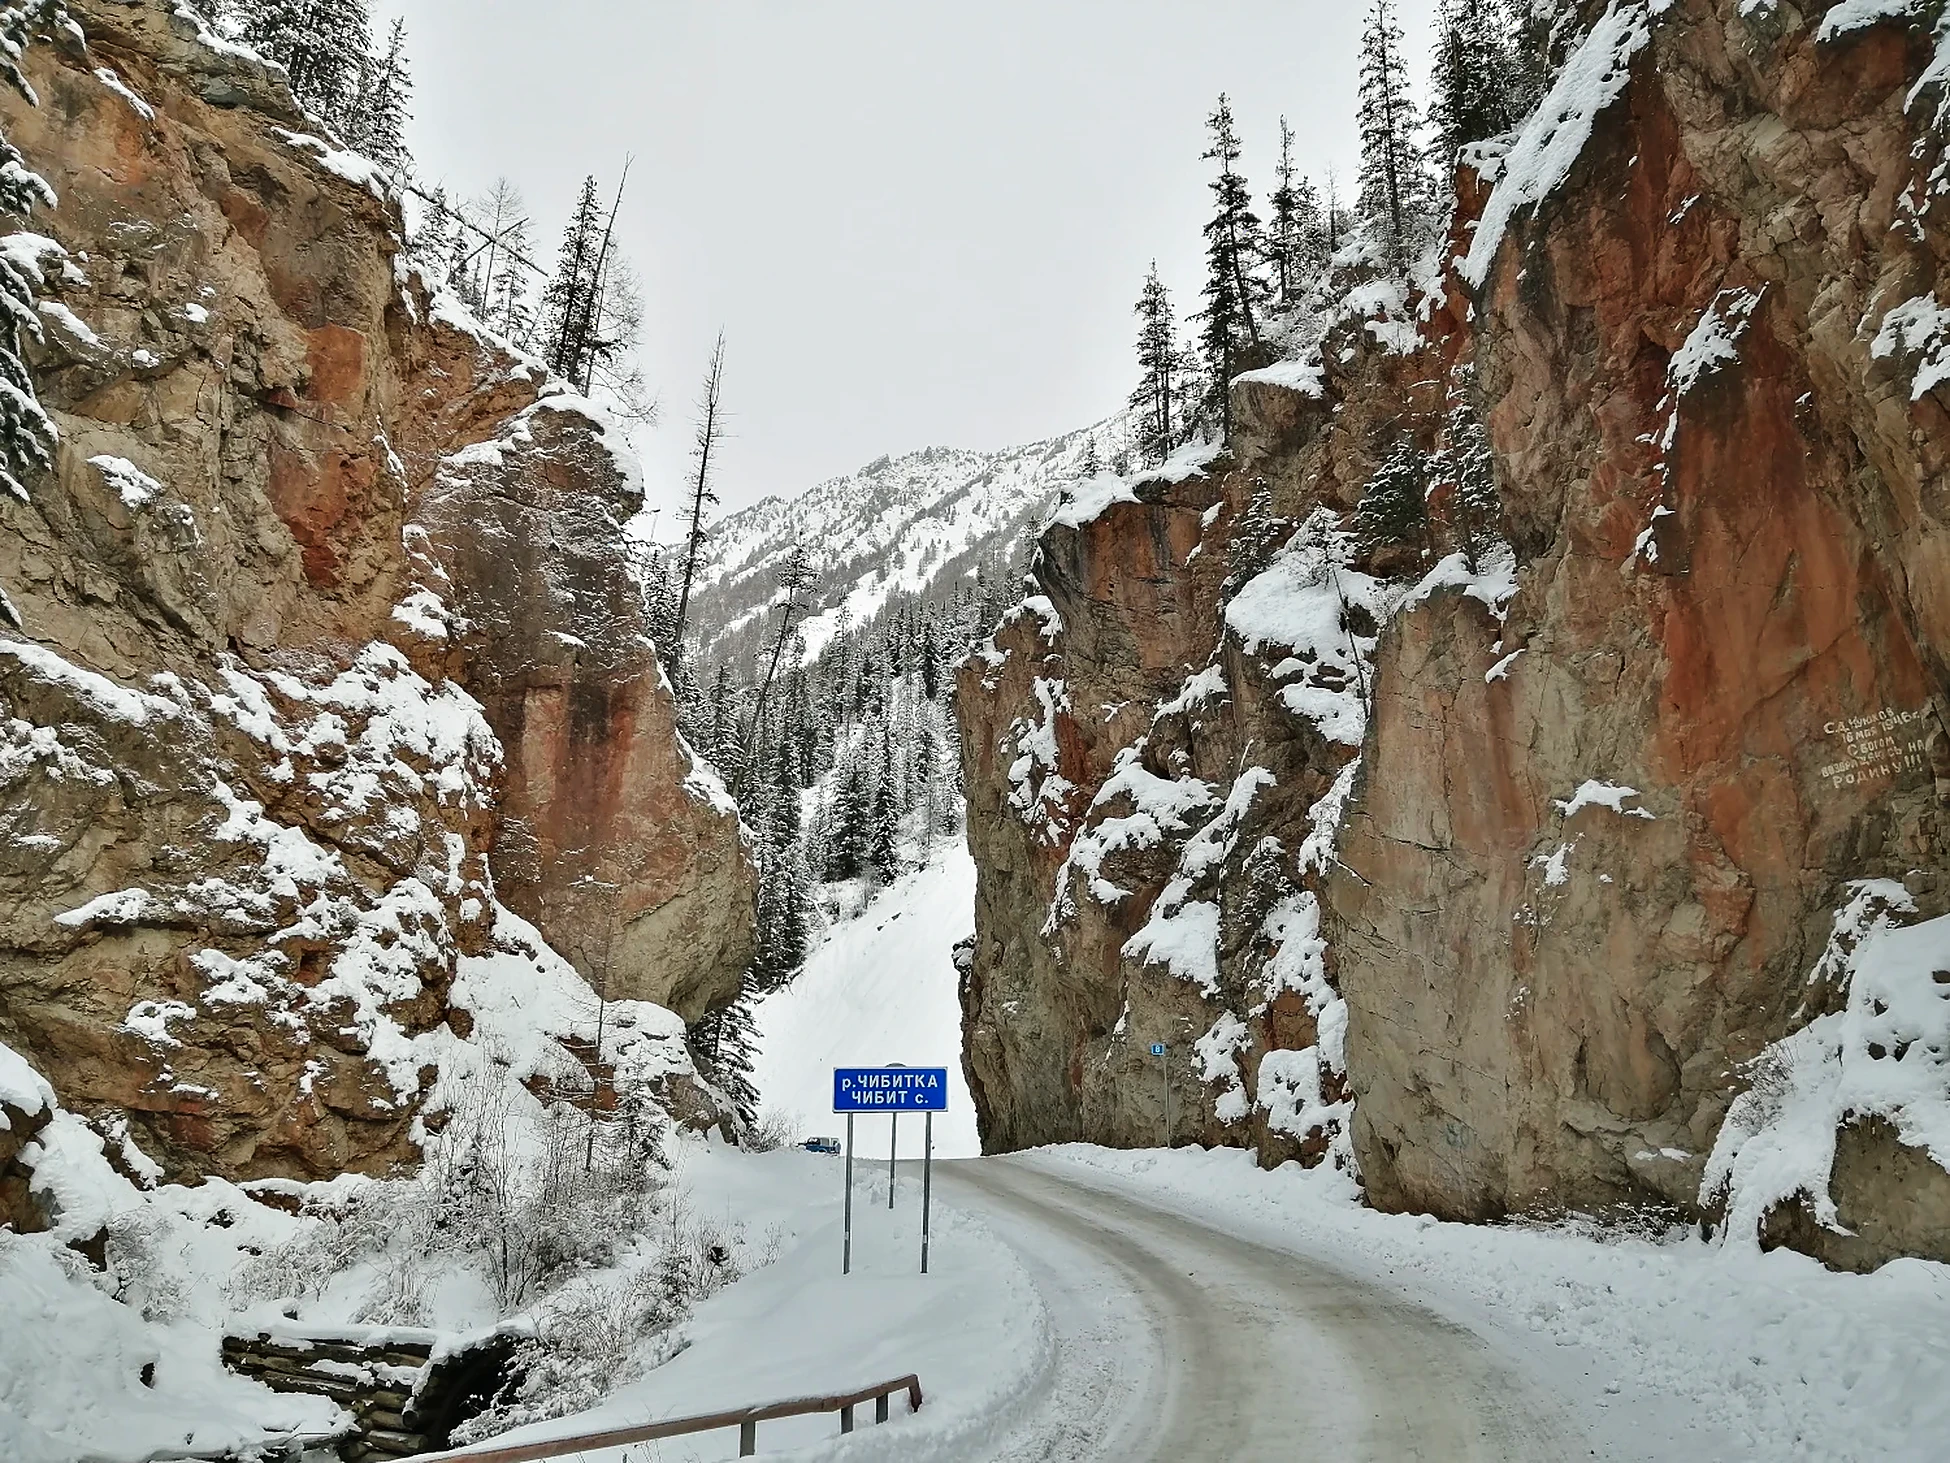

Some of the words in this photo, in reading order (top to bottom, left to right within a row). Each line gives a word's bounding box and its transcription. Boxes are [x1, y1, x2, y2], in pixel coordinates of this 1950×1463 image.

[1907, 739, 1925, 752] НА
[852, 1091, 908, 1104] ЧИБИТ
[915, 1094, 929, 1104] с.
